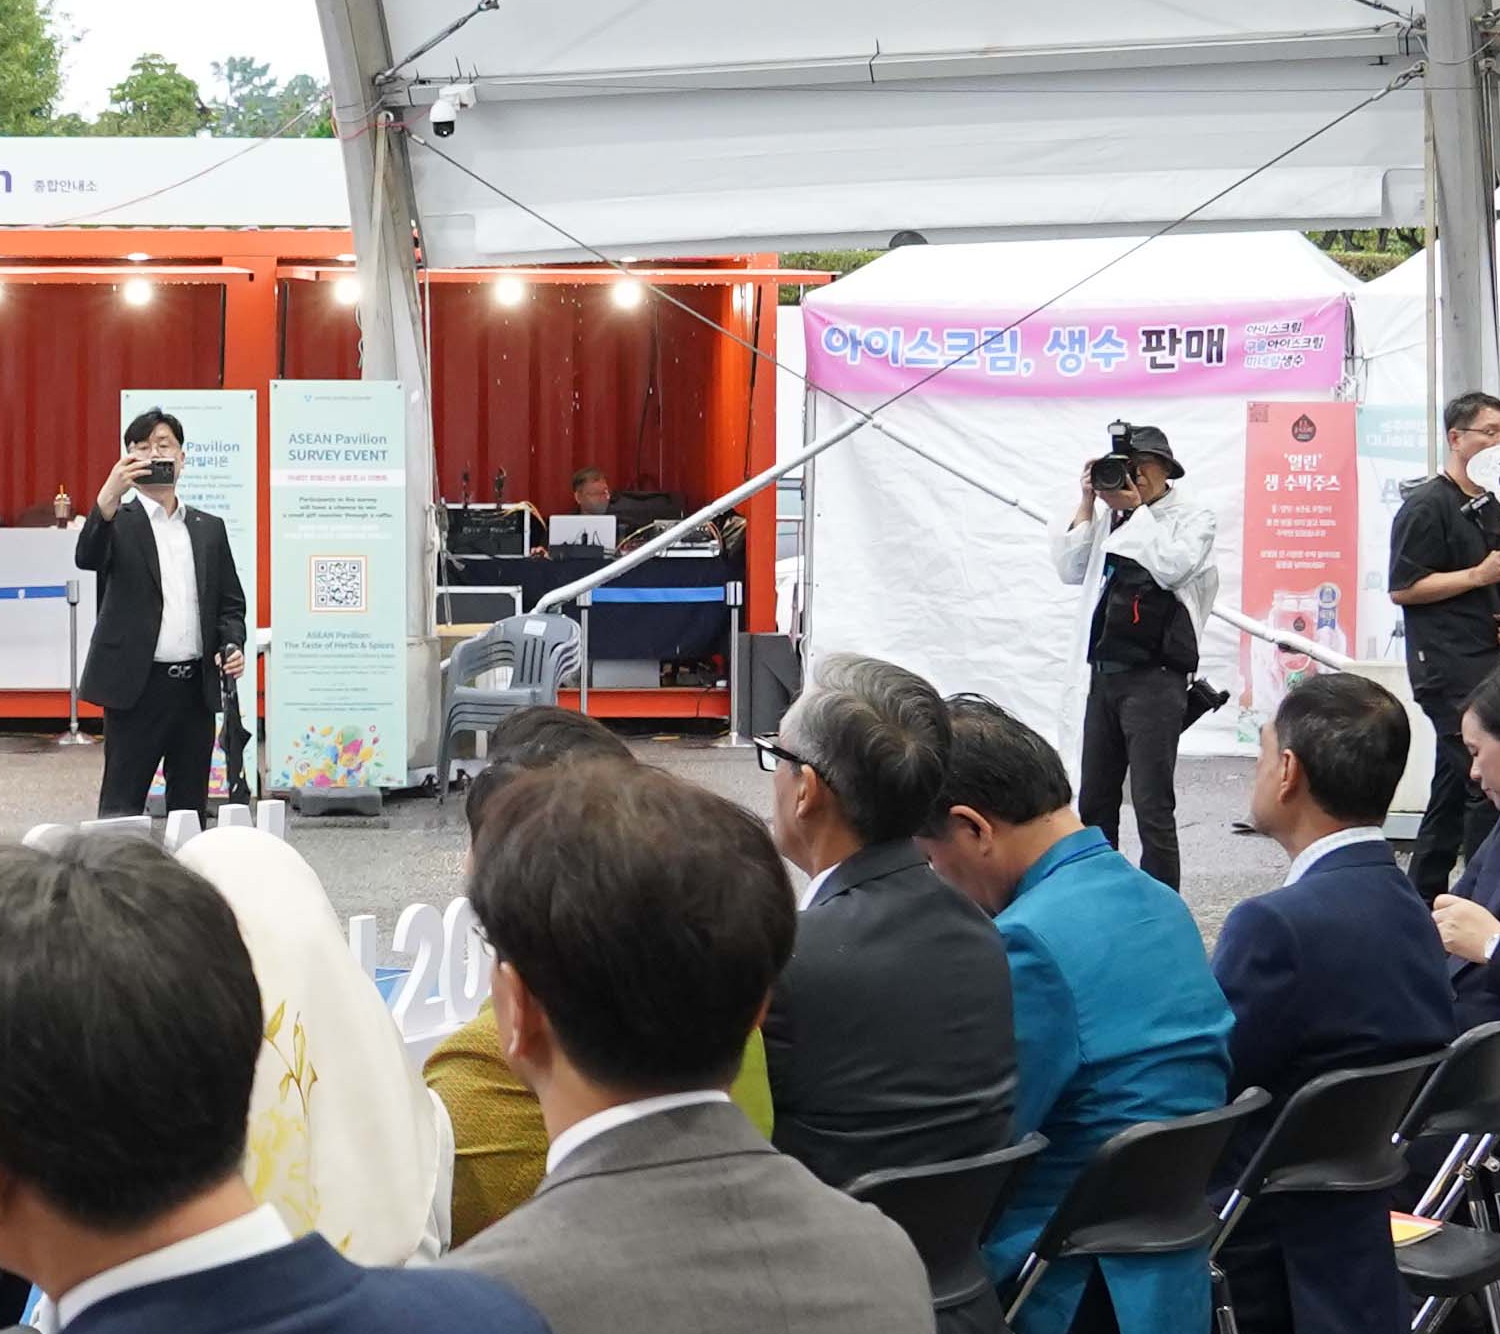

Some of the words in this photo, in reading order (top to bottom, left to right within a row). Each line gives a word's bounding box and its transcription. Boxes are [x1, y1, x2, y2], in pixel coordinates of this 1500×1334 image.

[33, 178, 98, 193] 종합안내소
[1246, 322, 1302, 334] 아이스크림
[822, 326, 1033, 375] 아이스크림,
[1046, 327, 1127, 374] 생수
[1141, 327, 1226, 370] 판매
[1246, 337, 1324, 352] 구슬아이스크림
[288, 433, 331, 445] ASEAN
[335, 432, 387, 445] Pavilion
[186, 440, 240, 453] Pavilion
[288, 449, 342, 462] SURVEY
[344, 449, 388, 461] EVENT
[1263, 474, 1279, 491] 생
[1284, 474, 1341, 491] 수박주스
[306, 631, 335, 639] ASEAN
